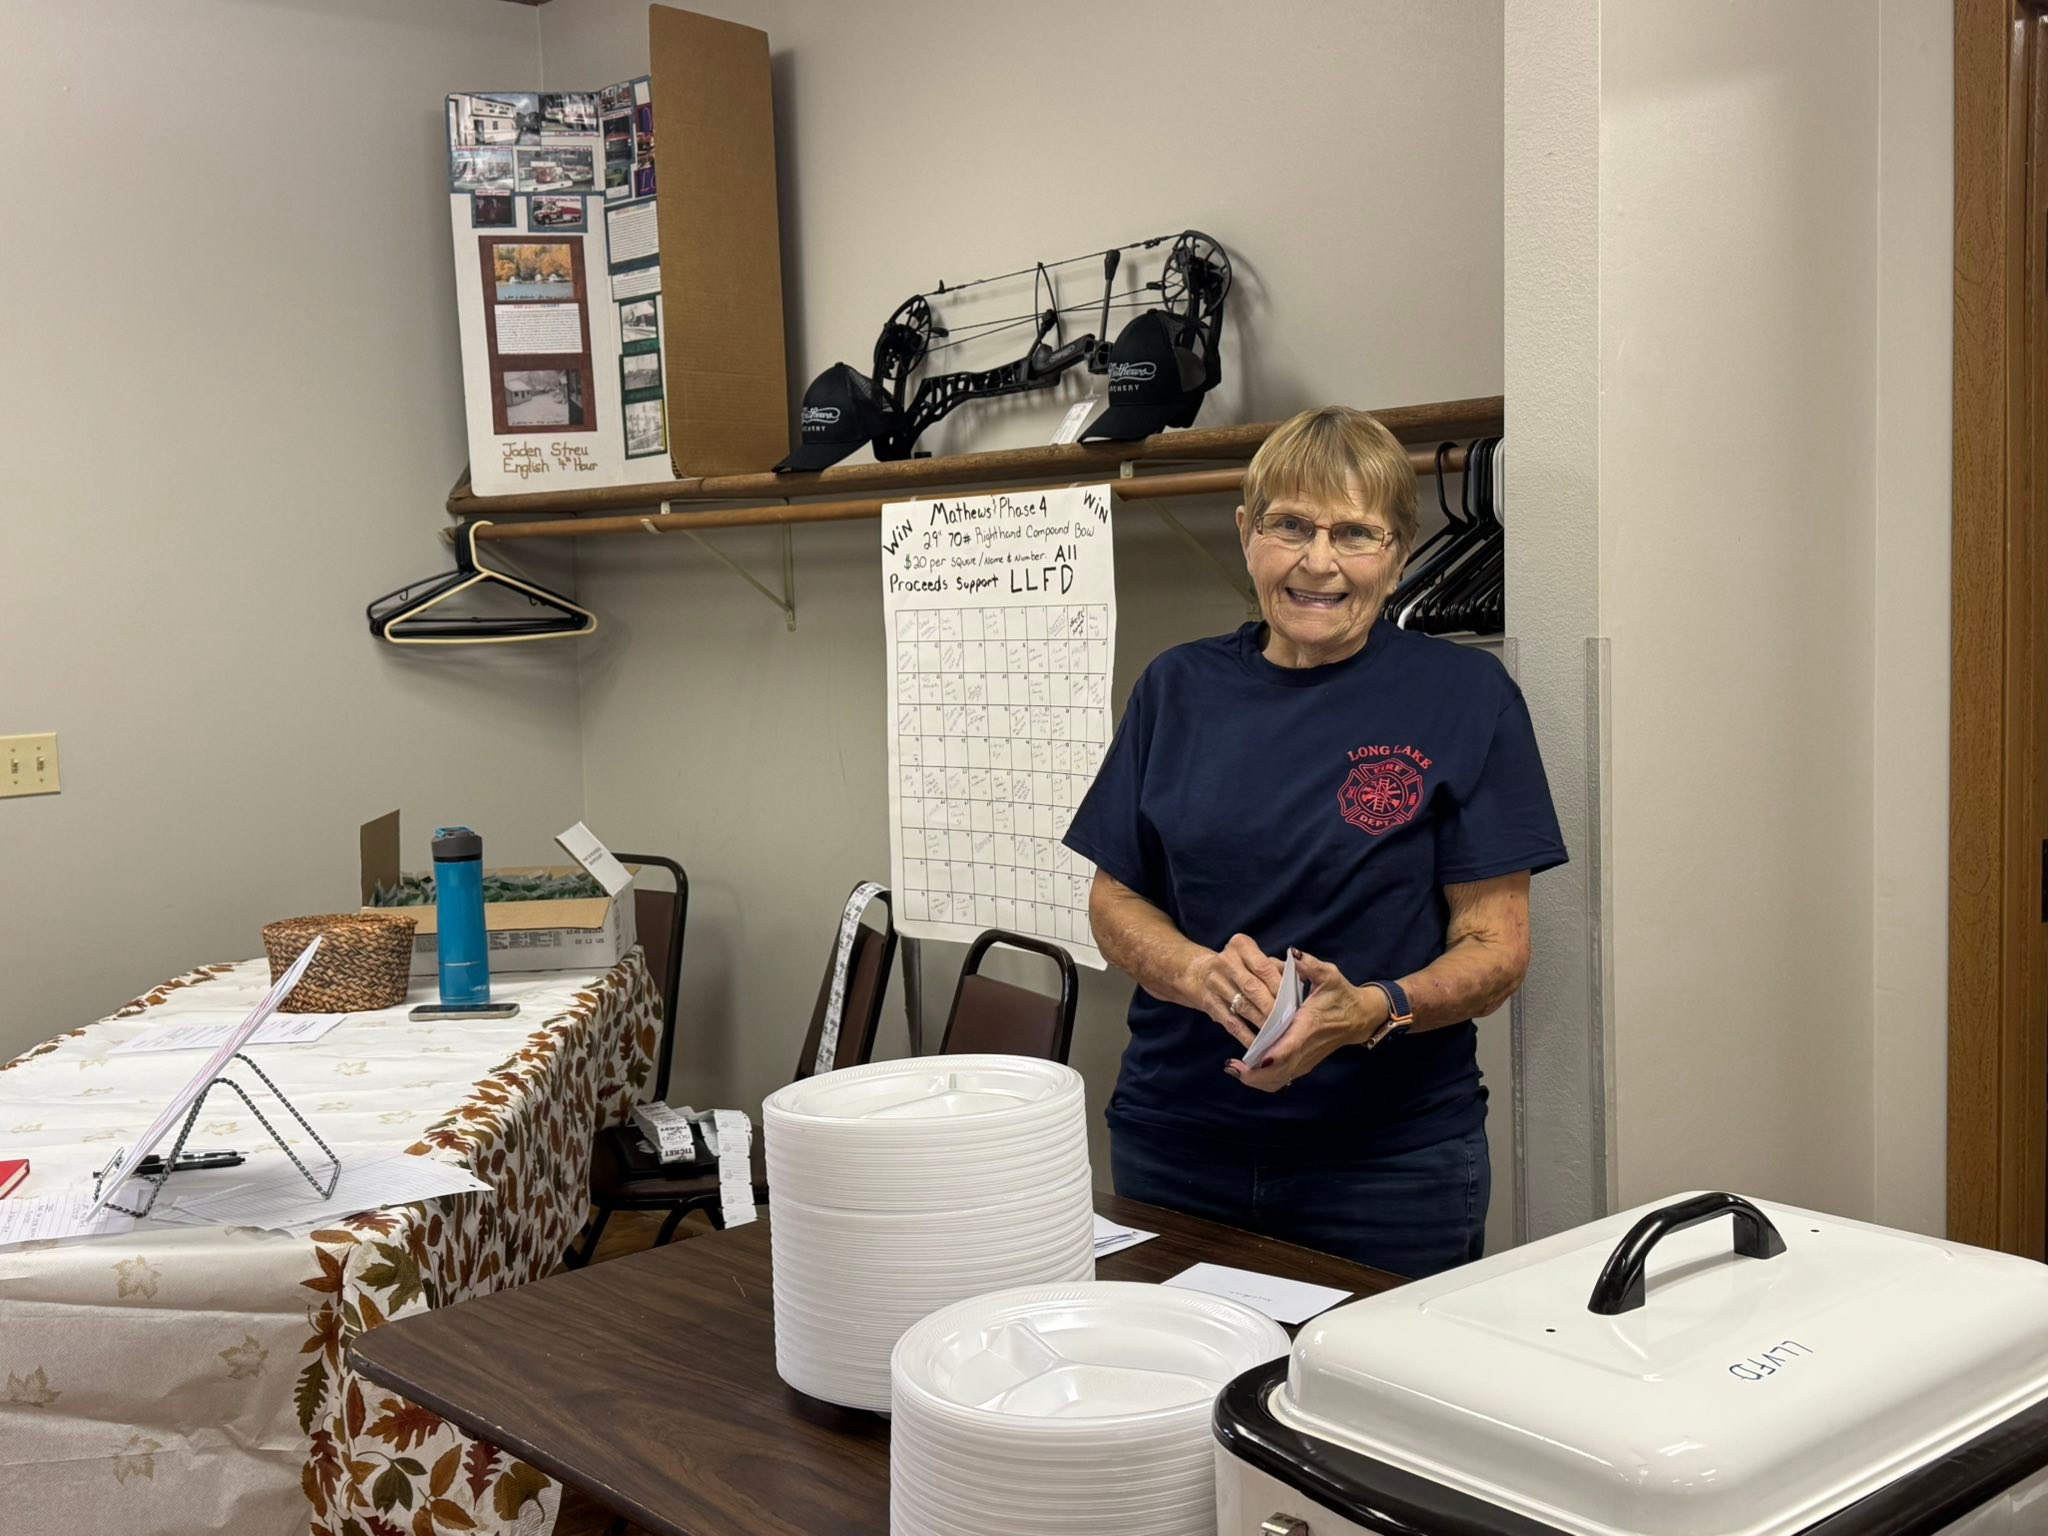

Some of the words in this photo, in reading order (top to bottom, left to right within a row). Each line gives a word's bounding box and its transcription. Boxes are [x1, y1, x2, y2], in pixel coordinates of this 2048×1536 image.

[550, 441, 589, 456] Streu
[503, 456, 550, 480] English
[574, 457, 598, 471] Hour
[999, 496, 1036, 519] Phase
[1039, 495, 1047, 518] 4
[948, 531, 971, 548] 70#
[1026, 520, 1069, 542] Compound
[1074, 522, 1095, 539] Bow
[904, 553, 927, 570] $20
[929, 557, 946, 573] per
[1055, 544, 1077, 563] All
[890, 573, 948, 593] Proceeds
[956, 573, 999, 594] Support
[1011, 564, 1073, 595] LLFD
[1347, 745, 1390, 761] LONG
[1393, 744, 1432, 769] LAKE
[1374, 763, 1403, 774] FIRE
[1359, 814, 1392, 827] DEPT
[665, 1147, 693, 1157] TICKET
[1729, 1340, 1814, 1380] LLVFD
